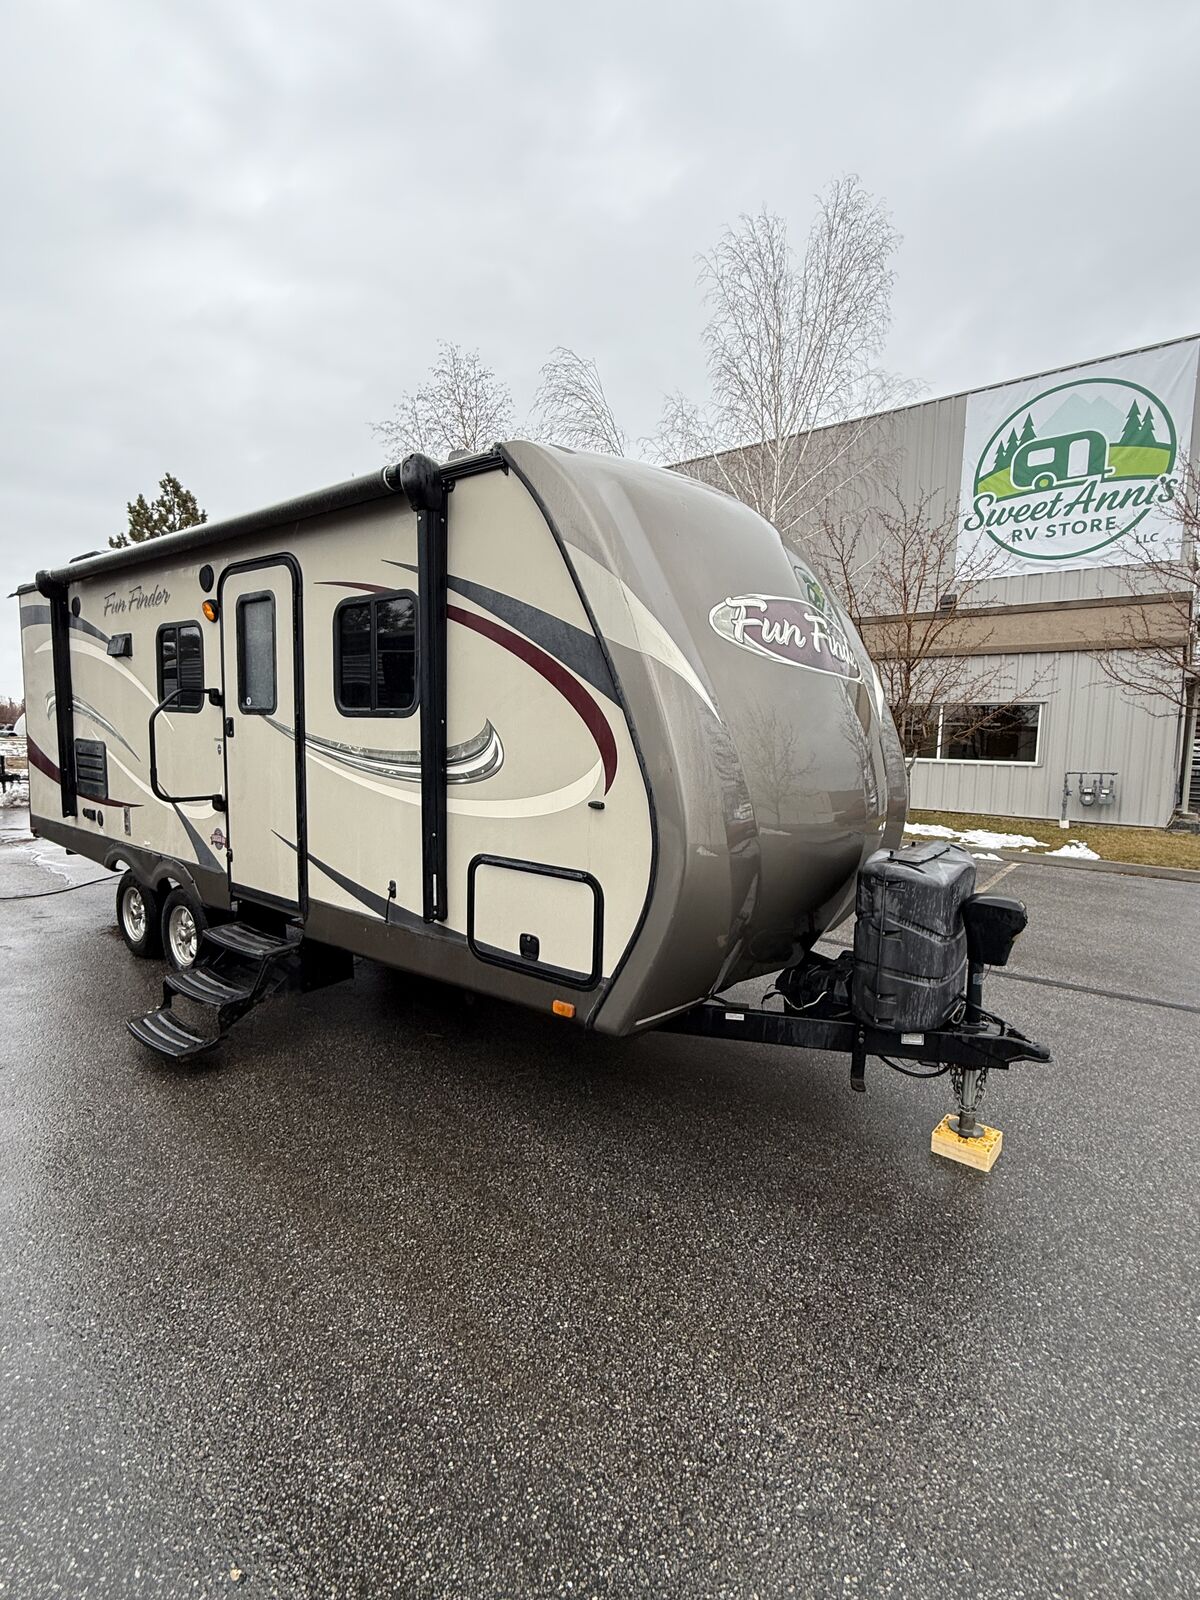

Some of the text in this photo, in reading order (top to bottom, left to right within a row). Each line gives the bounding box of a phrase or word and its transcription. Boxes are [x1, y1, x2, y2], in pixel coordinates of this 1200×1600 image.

[964, 491, 1064, 532] Sweet
[1011, 516, 1117, 543] RV STORE
[1136, 532, 1159, 544] LLC
[104, 584, 171, 617] Fun Finder
[725, 597, 807, 648] Fun
